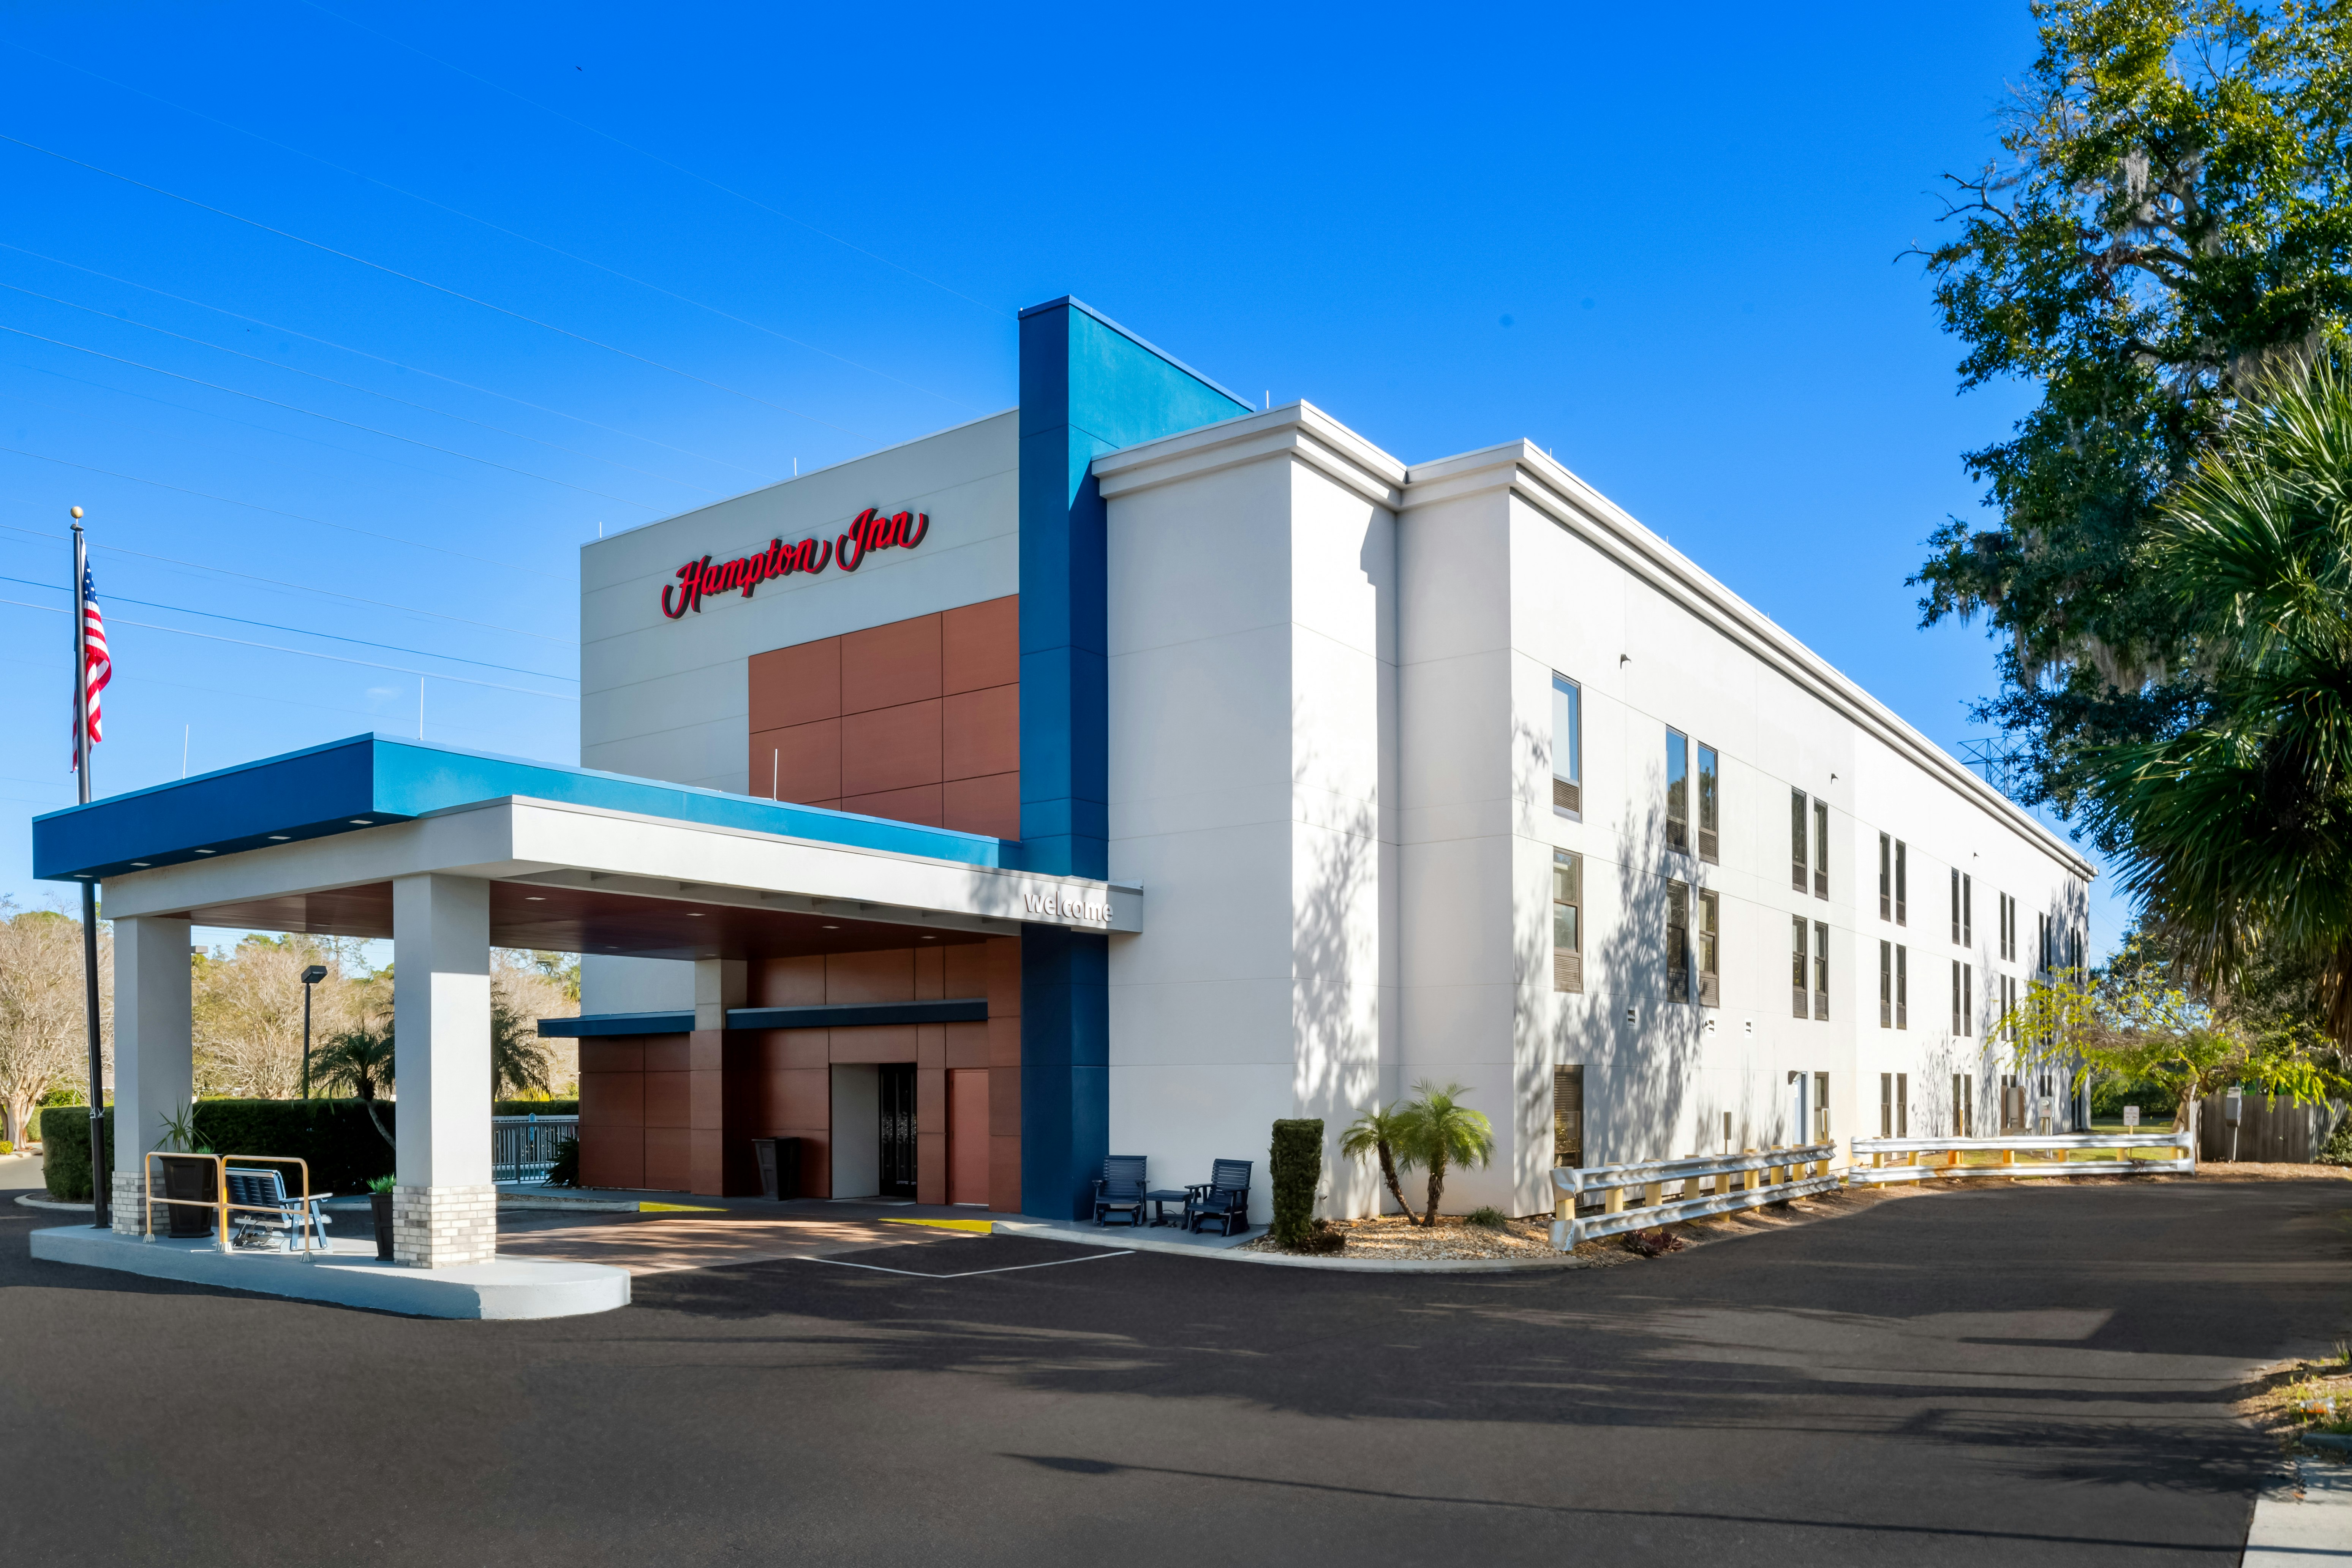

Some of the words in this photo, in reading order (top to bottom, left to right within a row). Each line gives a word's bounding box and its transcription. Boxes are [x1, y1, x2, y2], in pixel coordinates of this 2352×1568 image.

[662, 538, 833, 619] Hampton
[836, 508, 929, 572] Inn
[1024, 890, 1113, 922] welcome
